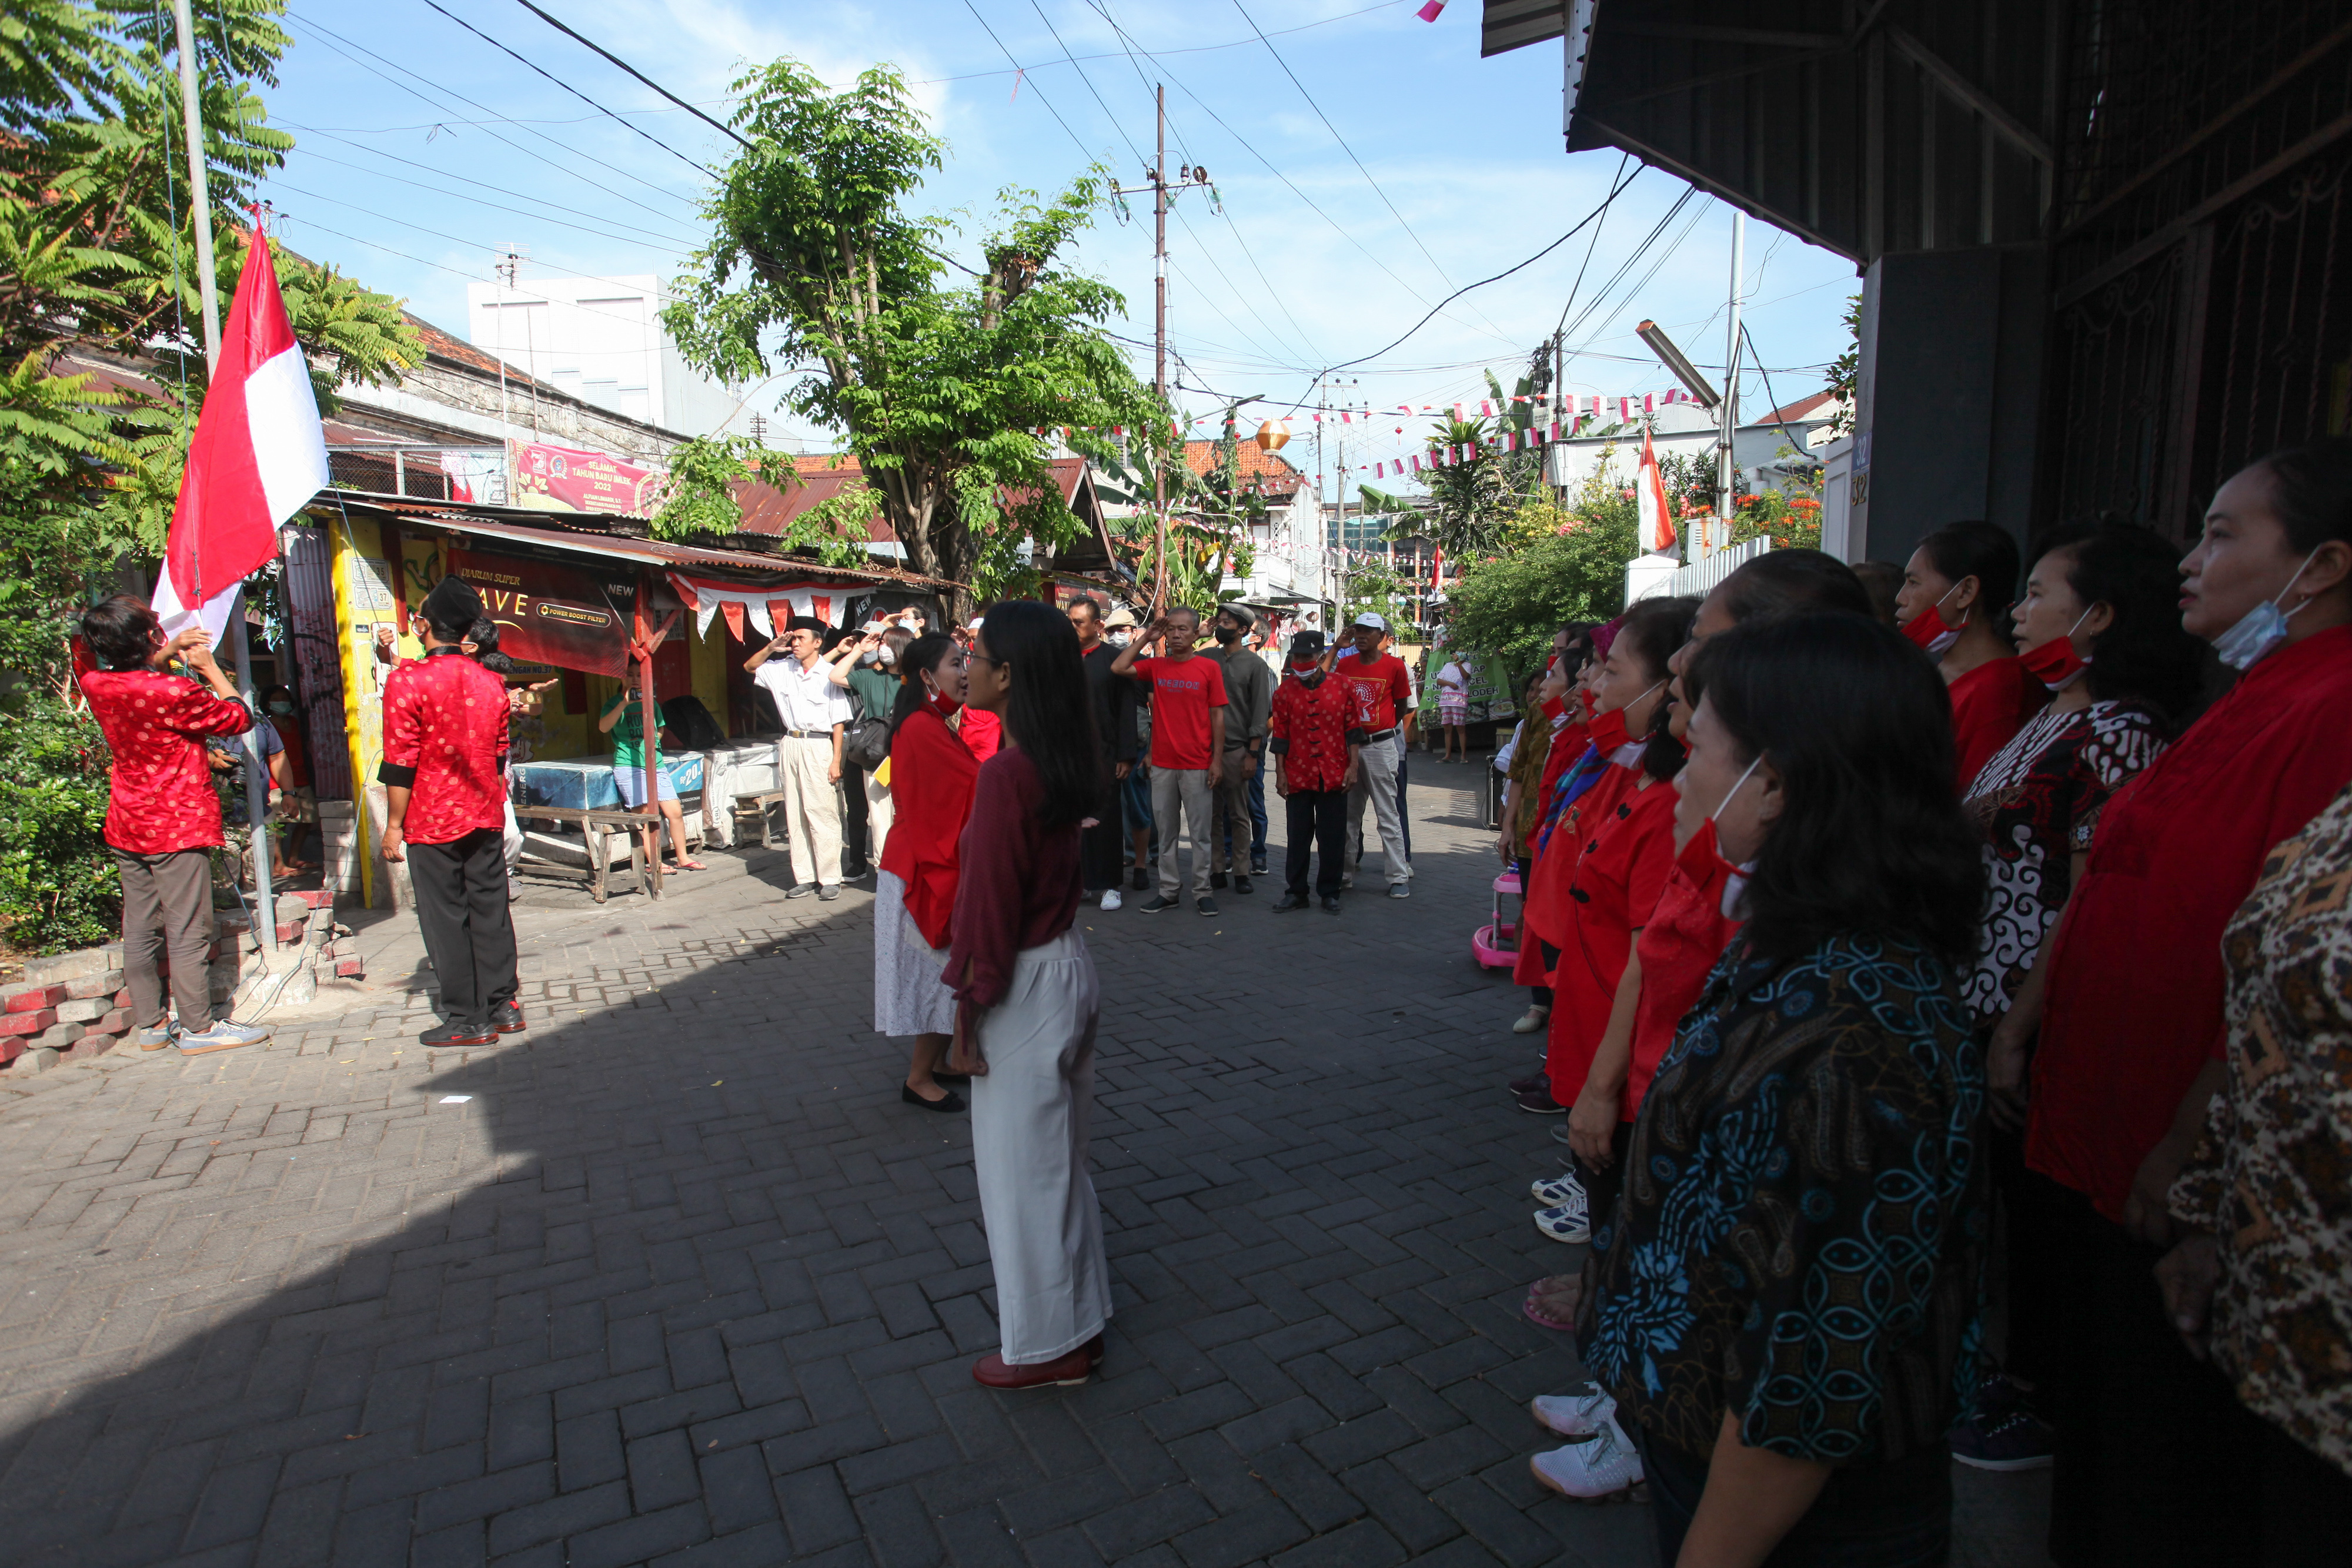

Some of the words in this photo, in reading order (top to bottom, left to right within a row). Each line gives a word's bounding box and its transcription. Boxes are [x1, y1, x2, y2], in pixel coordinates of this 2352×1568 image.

[1856, 435, 1866, 466] 32
[588, 461, 617, 473] SELAMAT
[572, 467, 594, 479] TAHUN
[595, 472, 613, 482] BARU
[613, 475, 632, 486] IMLEK
[594, 481, 612, 492] 2022
[1852, 474, 1866, 506] 32
[376, 567, 385, 576] 35
[462, 567, 493, 581] DJARUM
[494, 573, 520, 586] SUPER
[380, 593, 387, 601] 37
[608, 584, 633, 597] NEW
[479, 587, 528, 616] AVE
[856, 594, 871, 617] NEW
[550, 609, 568, 618] POWER
[569, 611, 587, 620] BOOST
[587, 615, 606, 623] FILTER
[533, 666, 552, 674] NO.37
[1157, 678, 1200, 690] FREEDOM
[1468, 687, 1498, 697] LODEH
